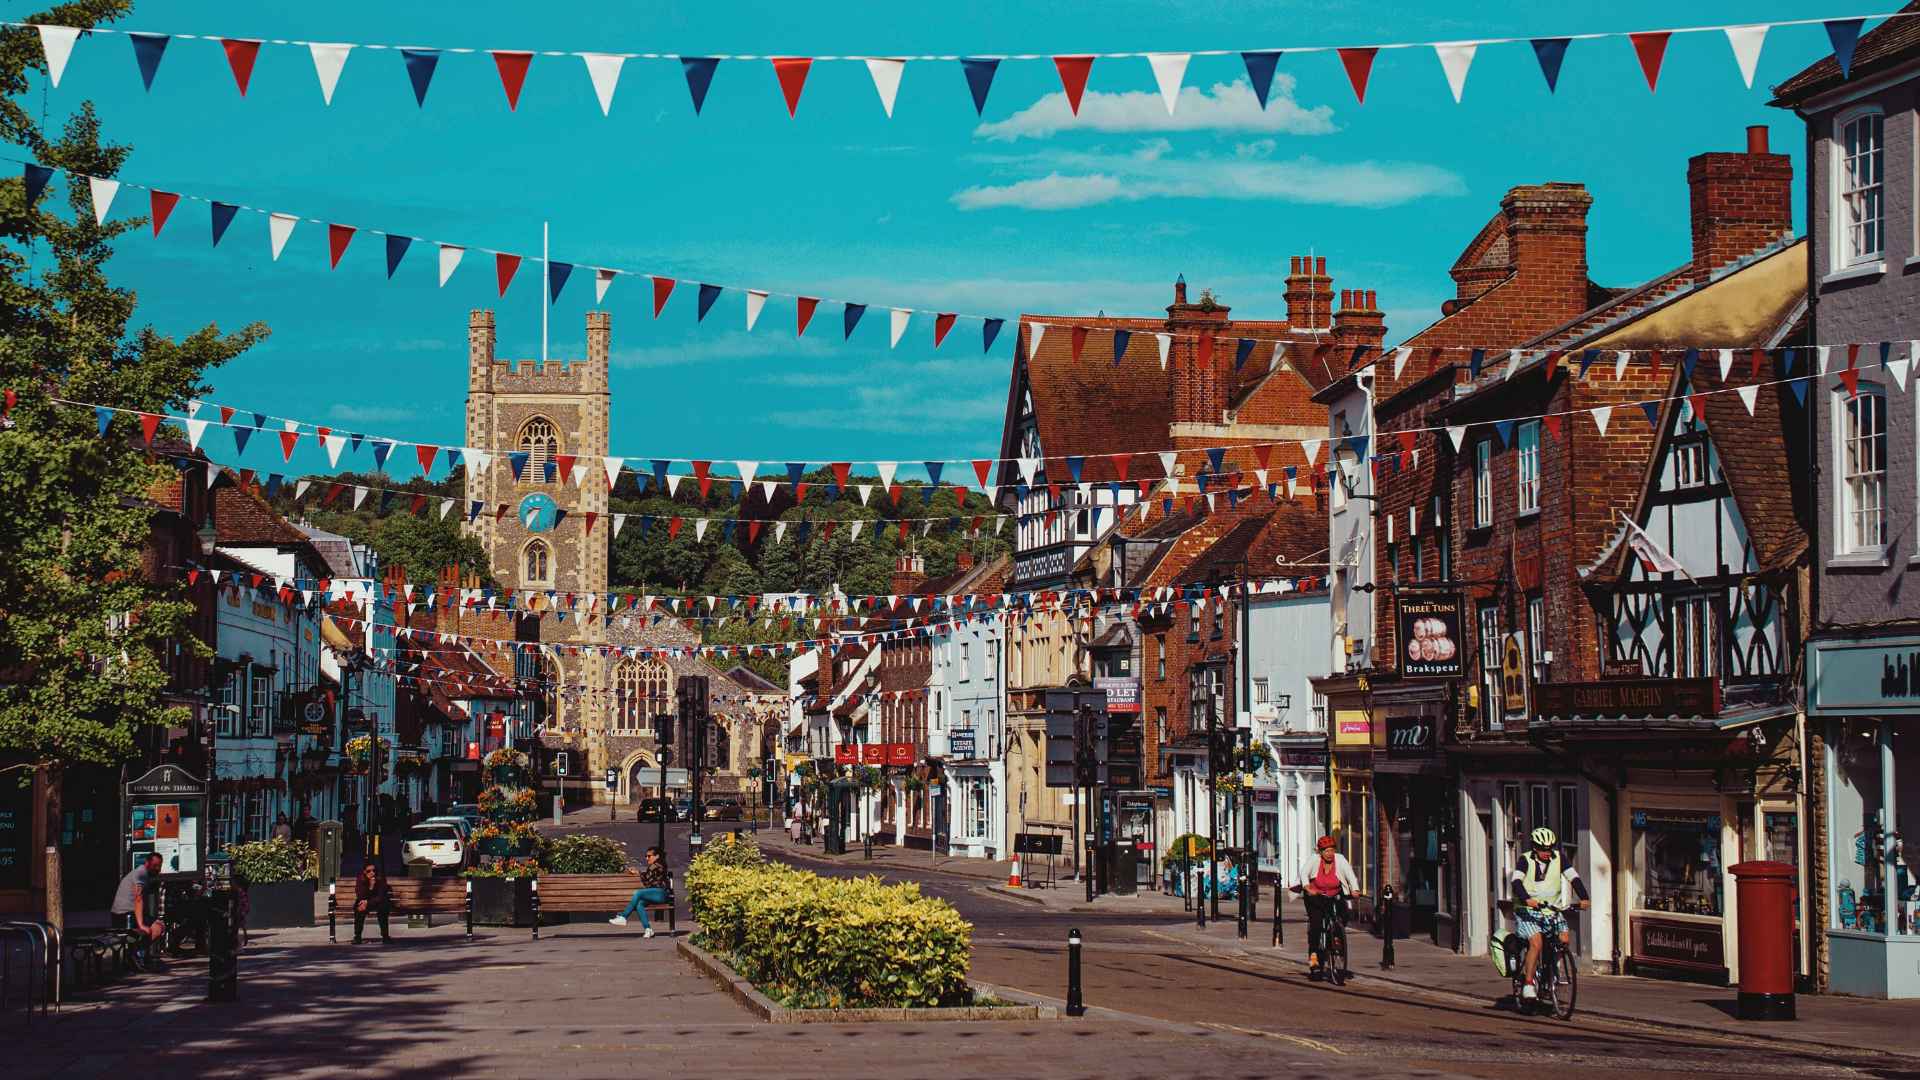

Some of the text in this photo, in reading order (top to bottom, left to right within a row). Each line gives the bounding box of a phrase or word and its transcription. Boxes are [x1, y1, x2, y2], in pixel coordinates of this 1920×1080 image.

[1402, 604, 1456, 613] THREE TUNS
[1406, 664, 1459, 674] Brakspear
[1116, 688, 1137, 697] LET
